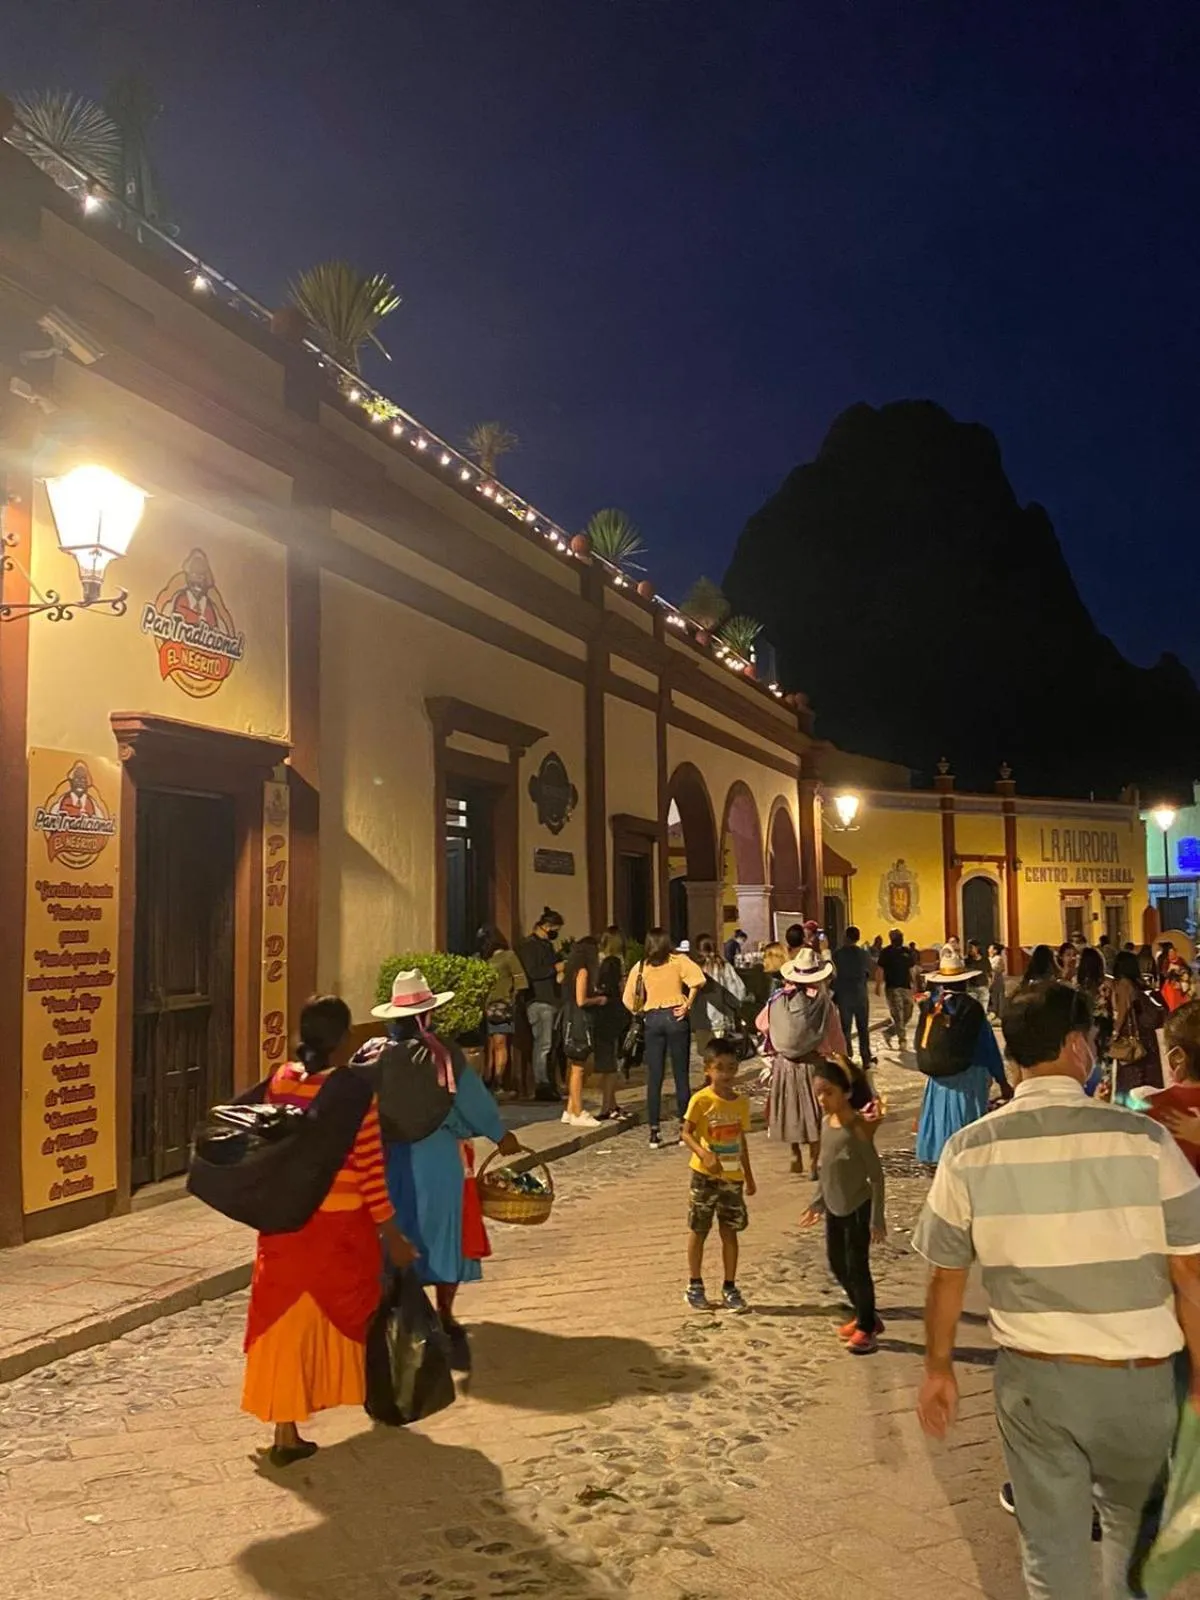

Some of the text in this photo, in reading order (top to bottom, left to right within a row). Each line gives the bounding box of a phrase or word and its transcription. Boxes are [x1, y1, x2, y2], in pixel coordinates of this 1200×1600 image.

[142, 604, 243, 658] Pan Tradicional
[167, 649, 221, 676] EL NEGRITO
[34, 809, 115, 834] Pan Tradicional
[1041, 829, 1120, 863] LA AURORA
[1024, 866, 1135, 883] CENTRO ARTESANAL
